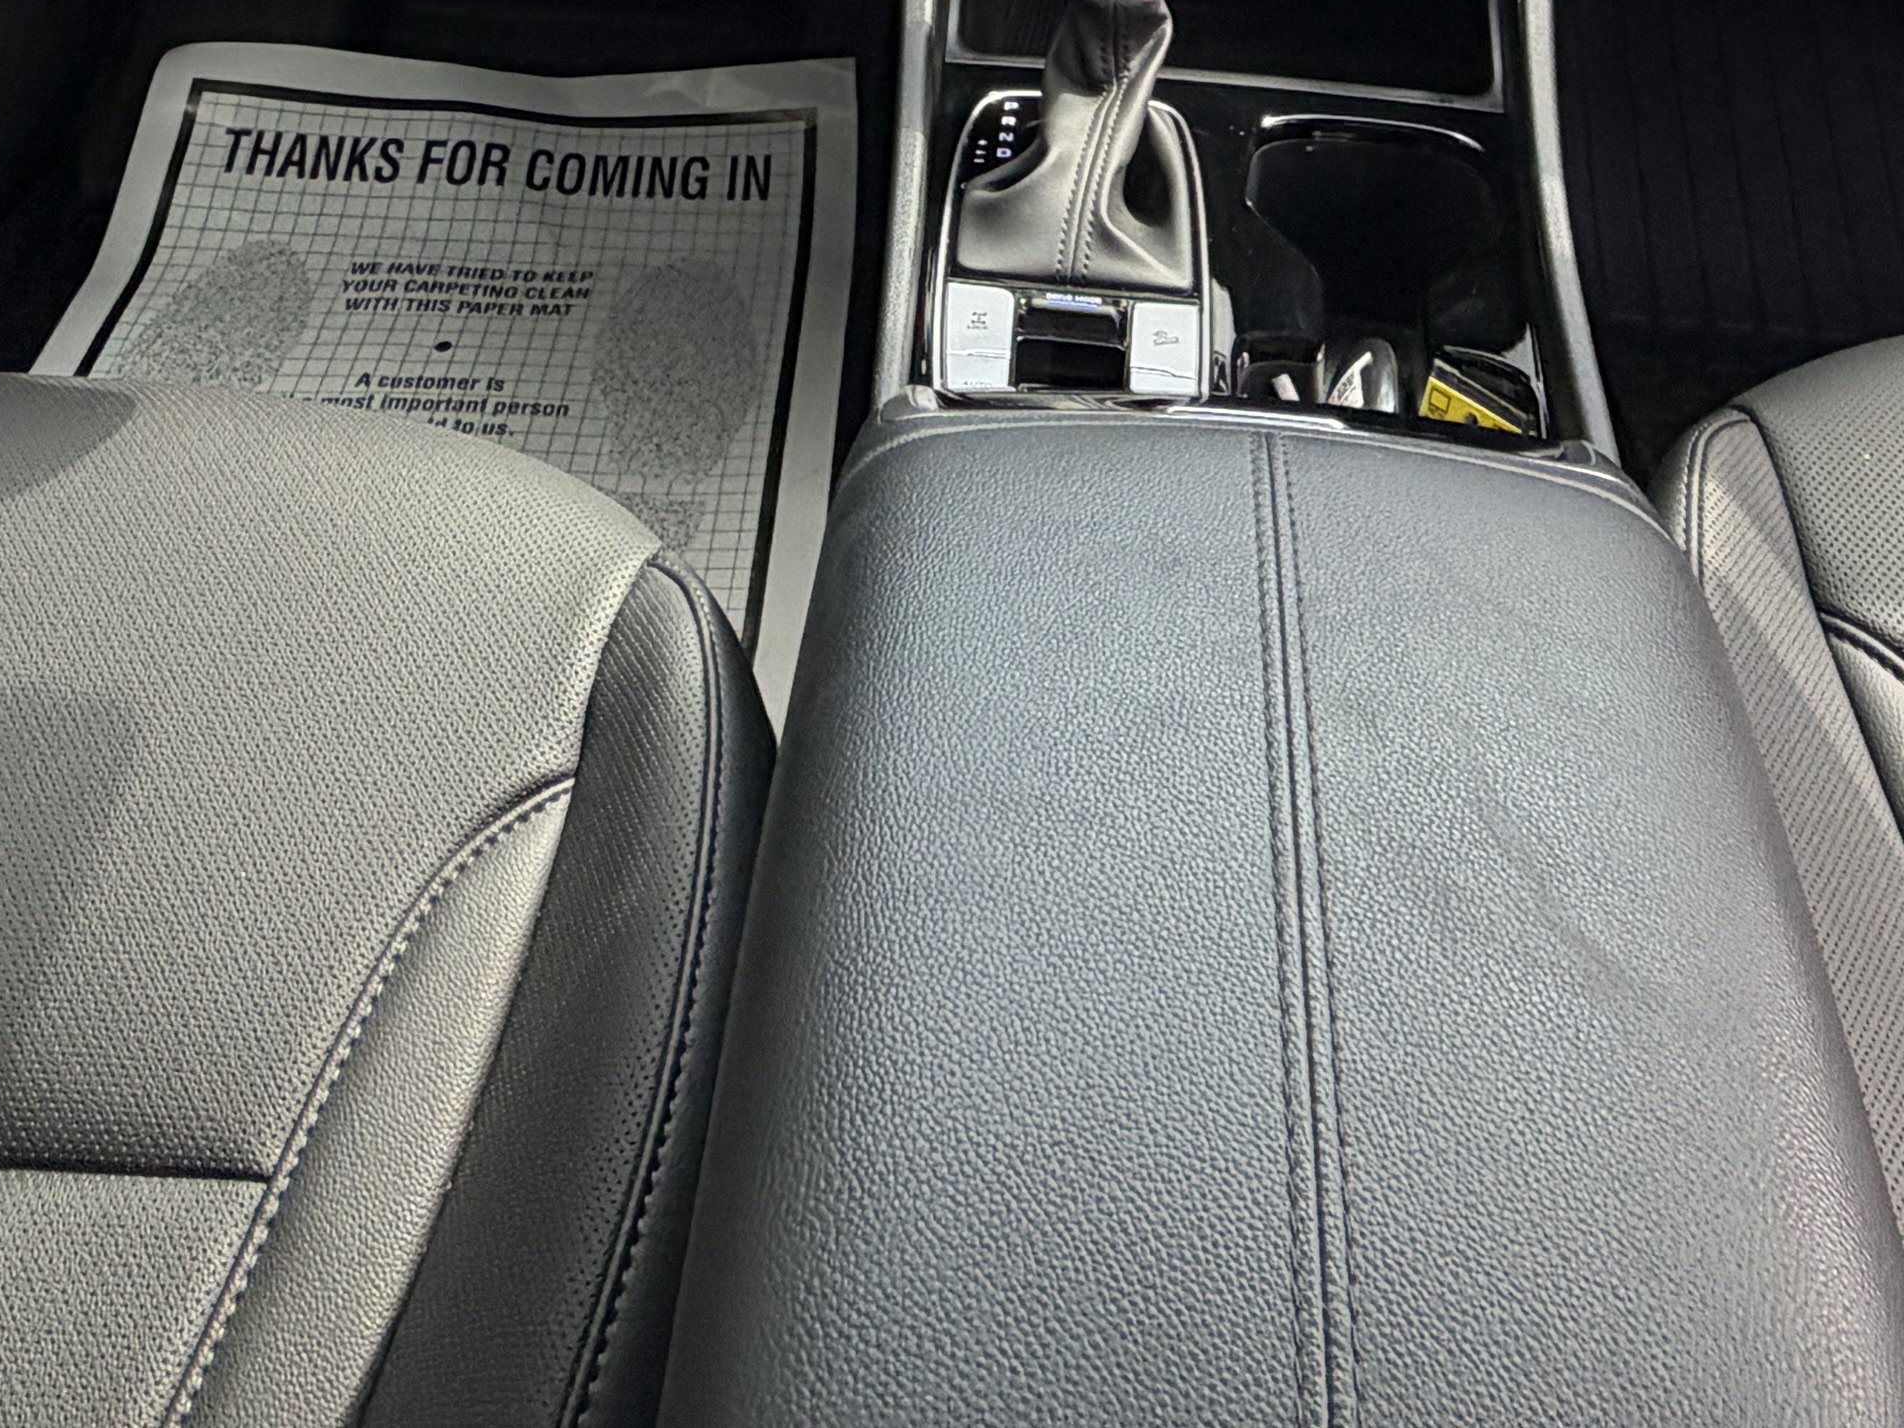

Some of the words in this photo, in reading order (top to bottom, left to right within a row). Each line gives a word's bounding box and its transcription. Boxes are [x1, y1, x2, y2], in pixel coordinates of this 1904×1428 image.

[996, 147, 1012, 158] D
[222, 127, 400, 185] THANKS
[416, 138, 507, 188] FOR
[527, 149, 711, 200] COMING
[726, 154, 771, 202] IN
[351, 262, 382, 275] WE
[387, 262, 440, 276] HAVE
[448, 265, 504, 280] TRIED
[512, 269, 537, 282] TO
[542, 270, 594, 283] KEEP
[342, 279, 398, 293] YOUR
[404, 281, 519, 299] CARPETING
[525, 286, 591, 300] CLEAN
[345, 298, 397, 312] WITH
[406, 298, 452, 313] THIS
[457, 300, 523, 316] PAPER
[530, 303, 575, 317] MAT
[355, 372, 371, 388] A
[378, 375, 480, 391] customer
[380, 396, 488, 416] important
[492, 400, 570, 418] person
[482, 421, 515, 436] us.
